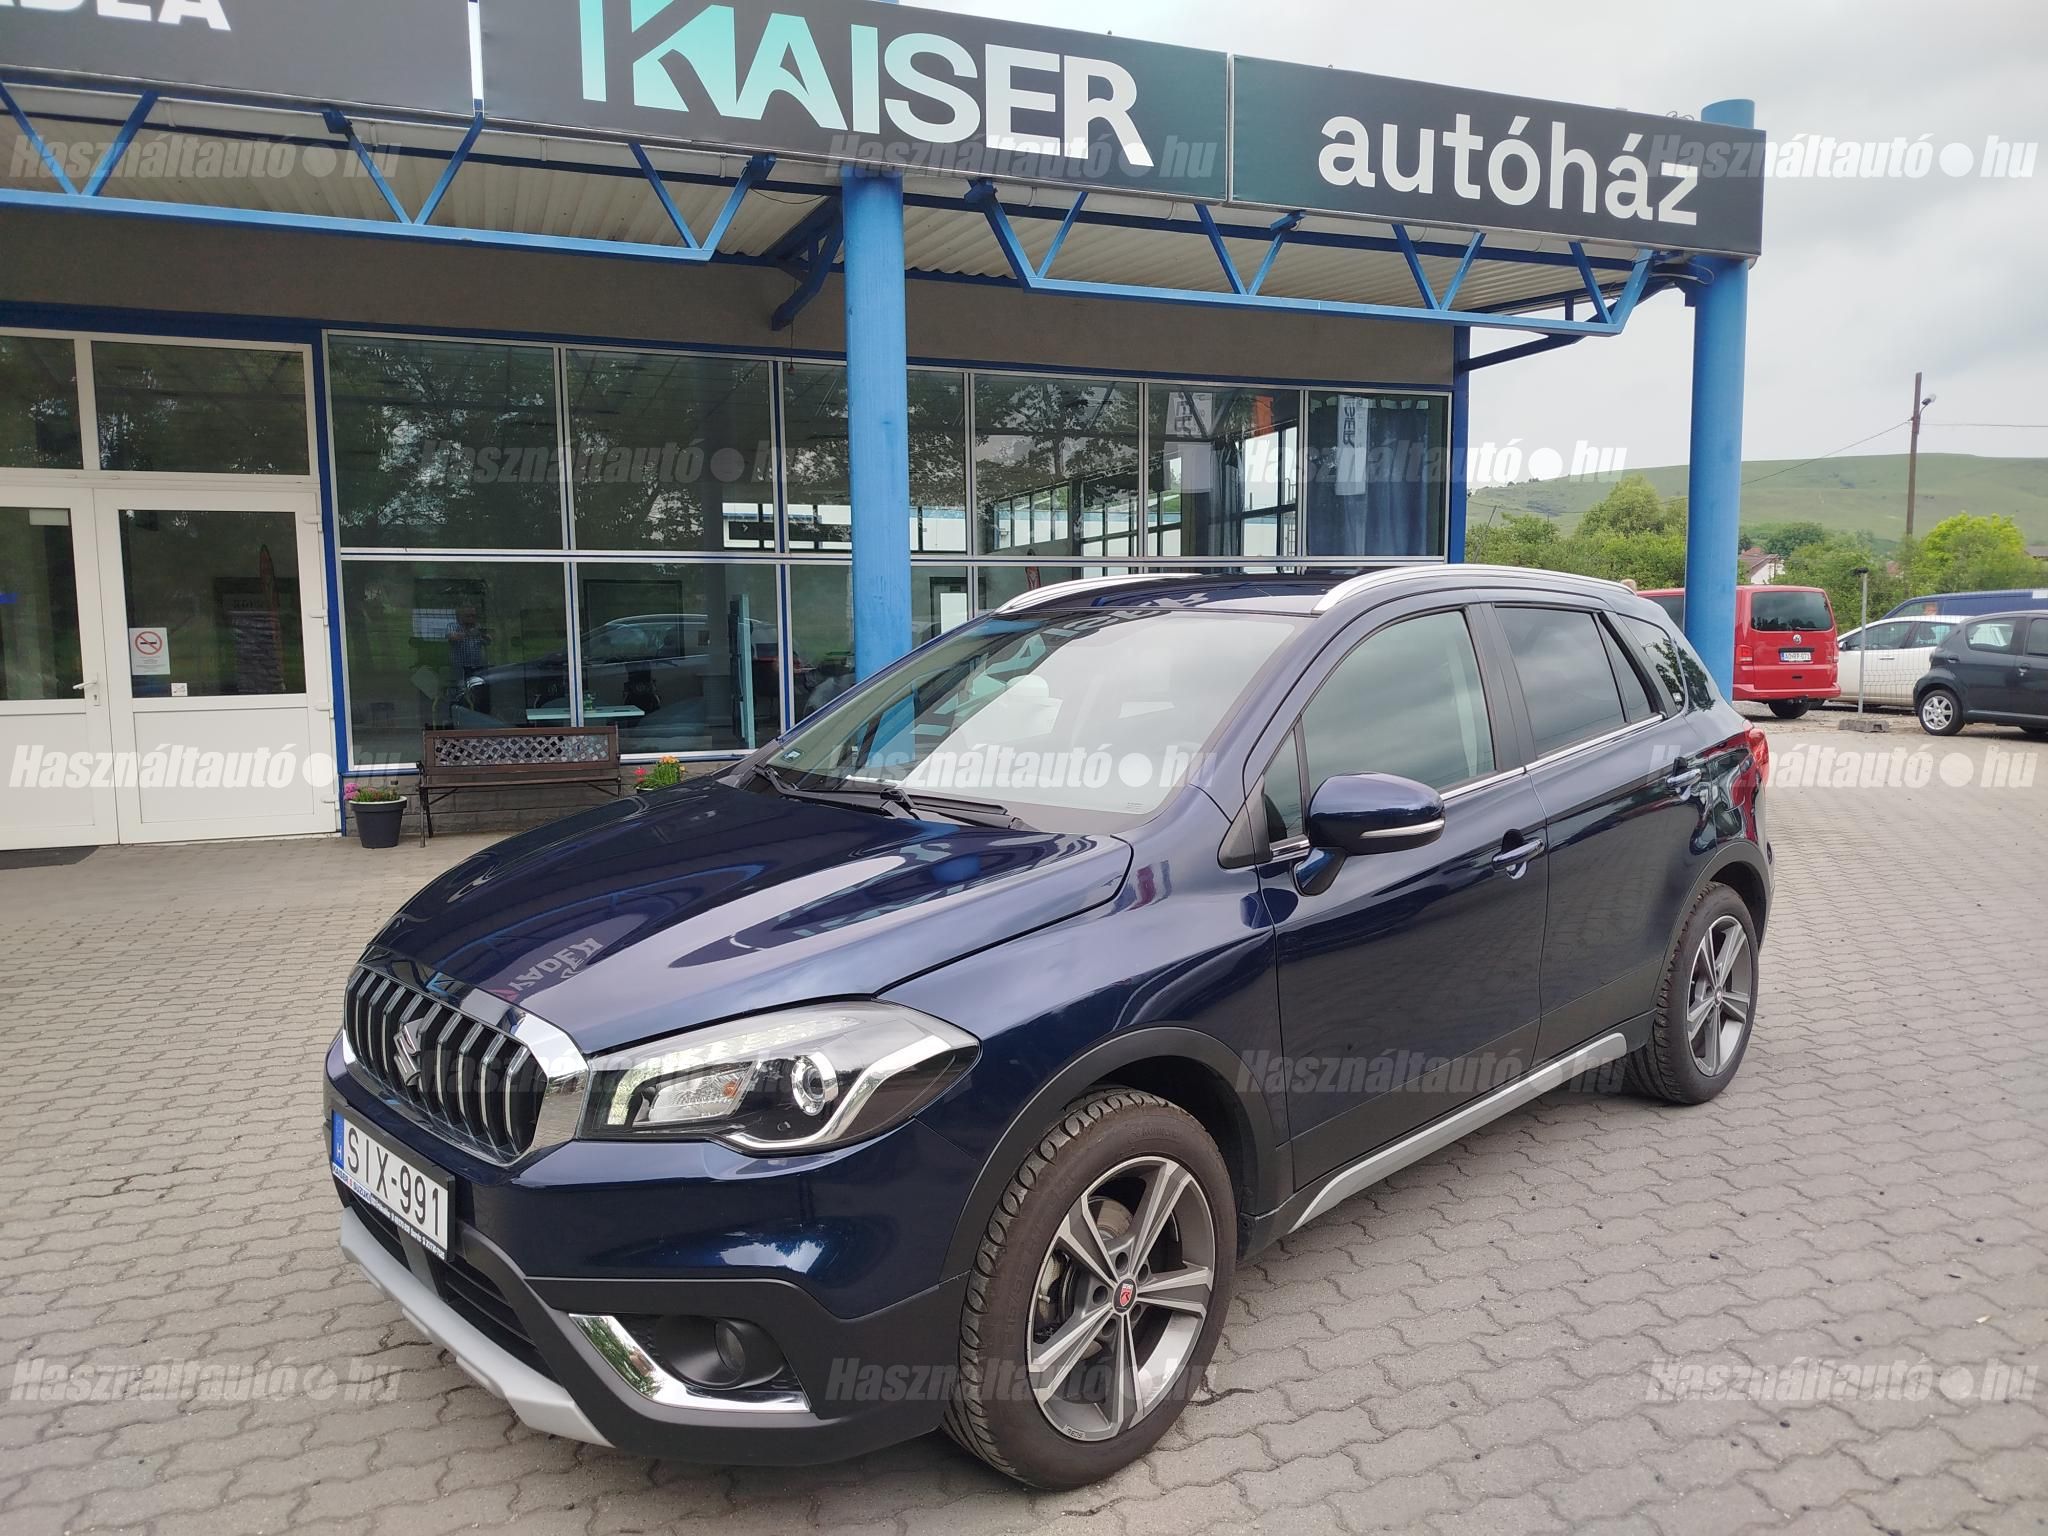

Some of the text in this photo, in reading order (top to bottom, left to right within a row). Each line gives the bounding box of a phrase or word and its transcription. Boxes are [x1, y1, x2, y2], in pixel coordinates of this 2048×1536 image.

[579, 0, 1154, 167] KAISER
[1318, 113, 1698, 227] autóház
[347, 1127, 439, 1237] SIX-991
